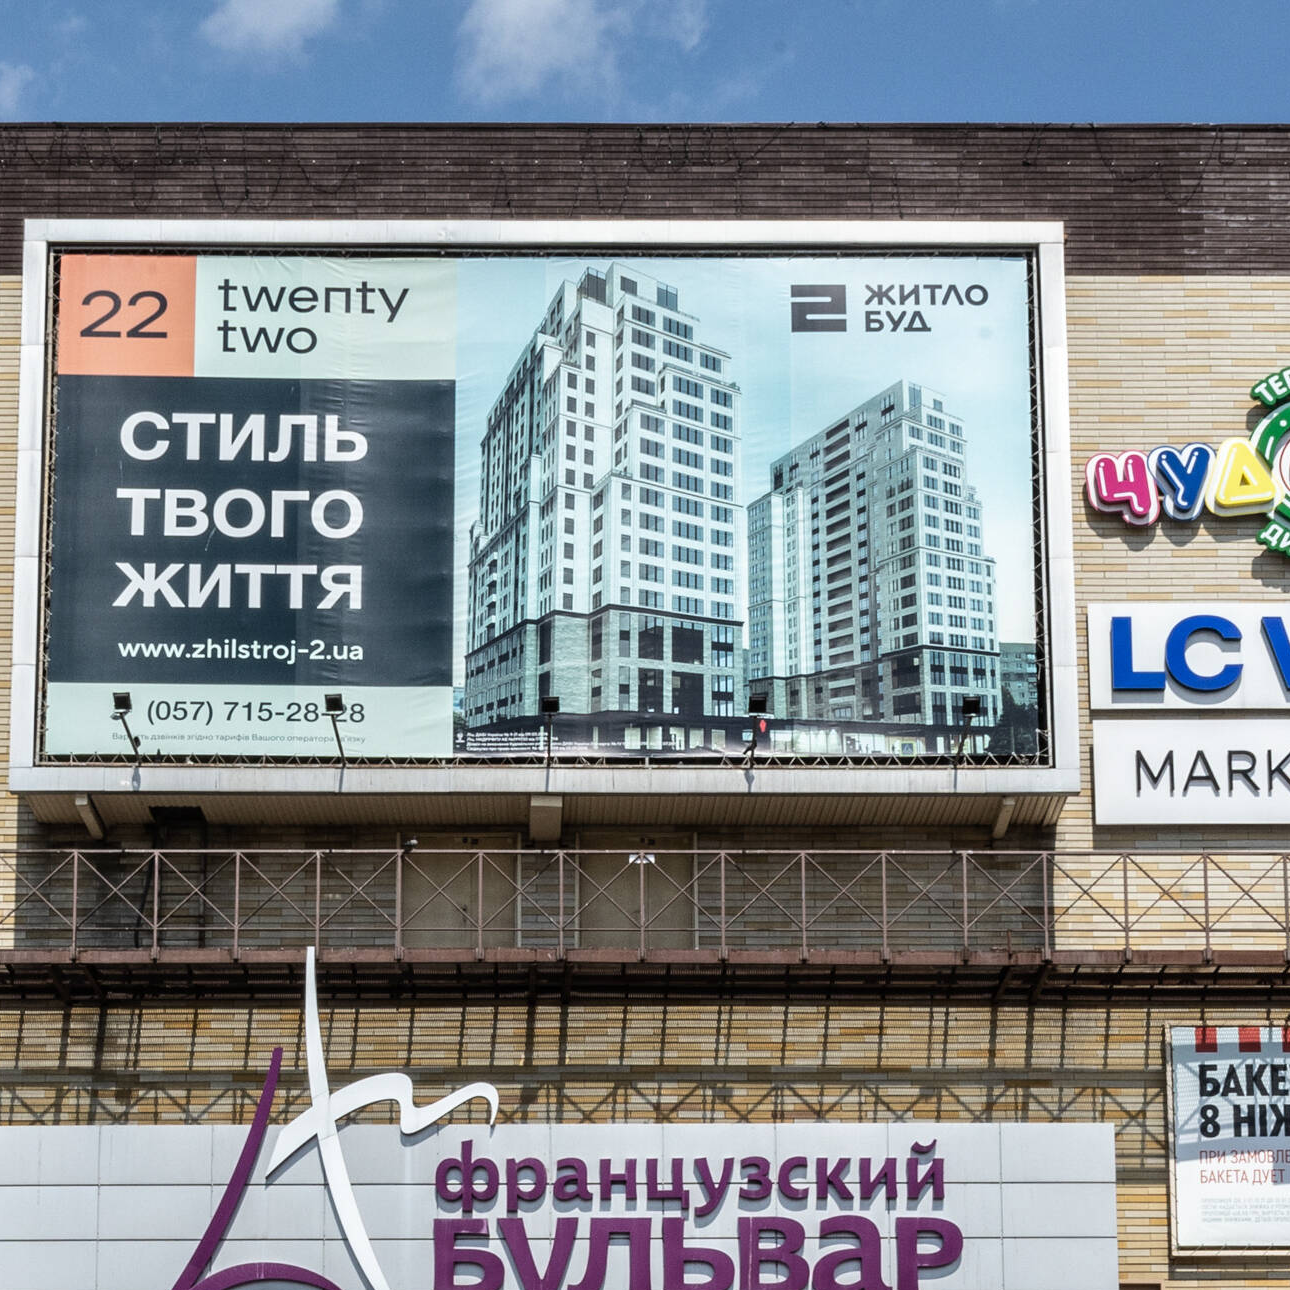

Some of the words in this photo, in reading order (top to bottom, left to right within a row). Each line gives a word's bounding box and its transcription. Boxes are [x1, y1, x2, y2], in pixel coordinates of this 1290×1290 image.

[217, 278, 409, 322] twenty
[864, 284, 989, 306] ЖИТЛО
[79, 290, 169, 340] 22
[864, 310, 932, 333] БУД
[216, 318, 318, 354] two
[119, 411, 369, 463] СТИЛЬ
[116, 488, 364, 539] ТВОГО
[112, 562, 362, 610] ЖИТТЯ
[118, 638, 364, 665] www.zhilstroj-2.ua
[1111, 614, 1244, 692] LC
[147, 700, 214, 726] (057)
[1200, 1104, 1218, 1138] 8
[1199, 1150, 1227, 1164] ПРИ
[434, 1139, 945, 1217] французский
[1199, 1170, 1249, 1184] БАКЕТА
[1252, 1168, 1285, 1186] ДУЕТ
